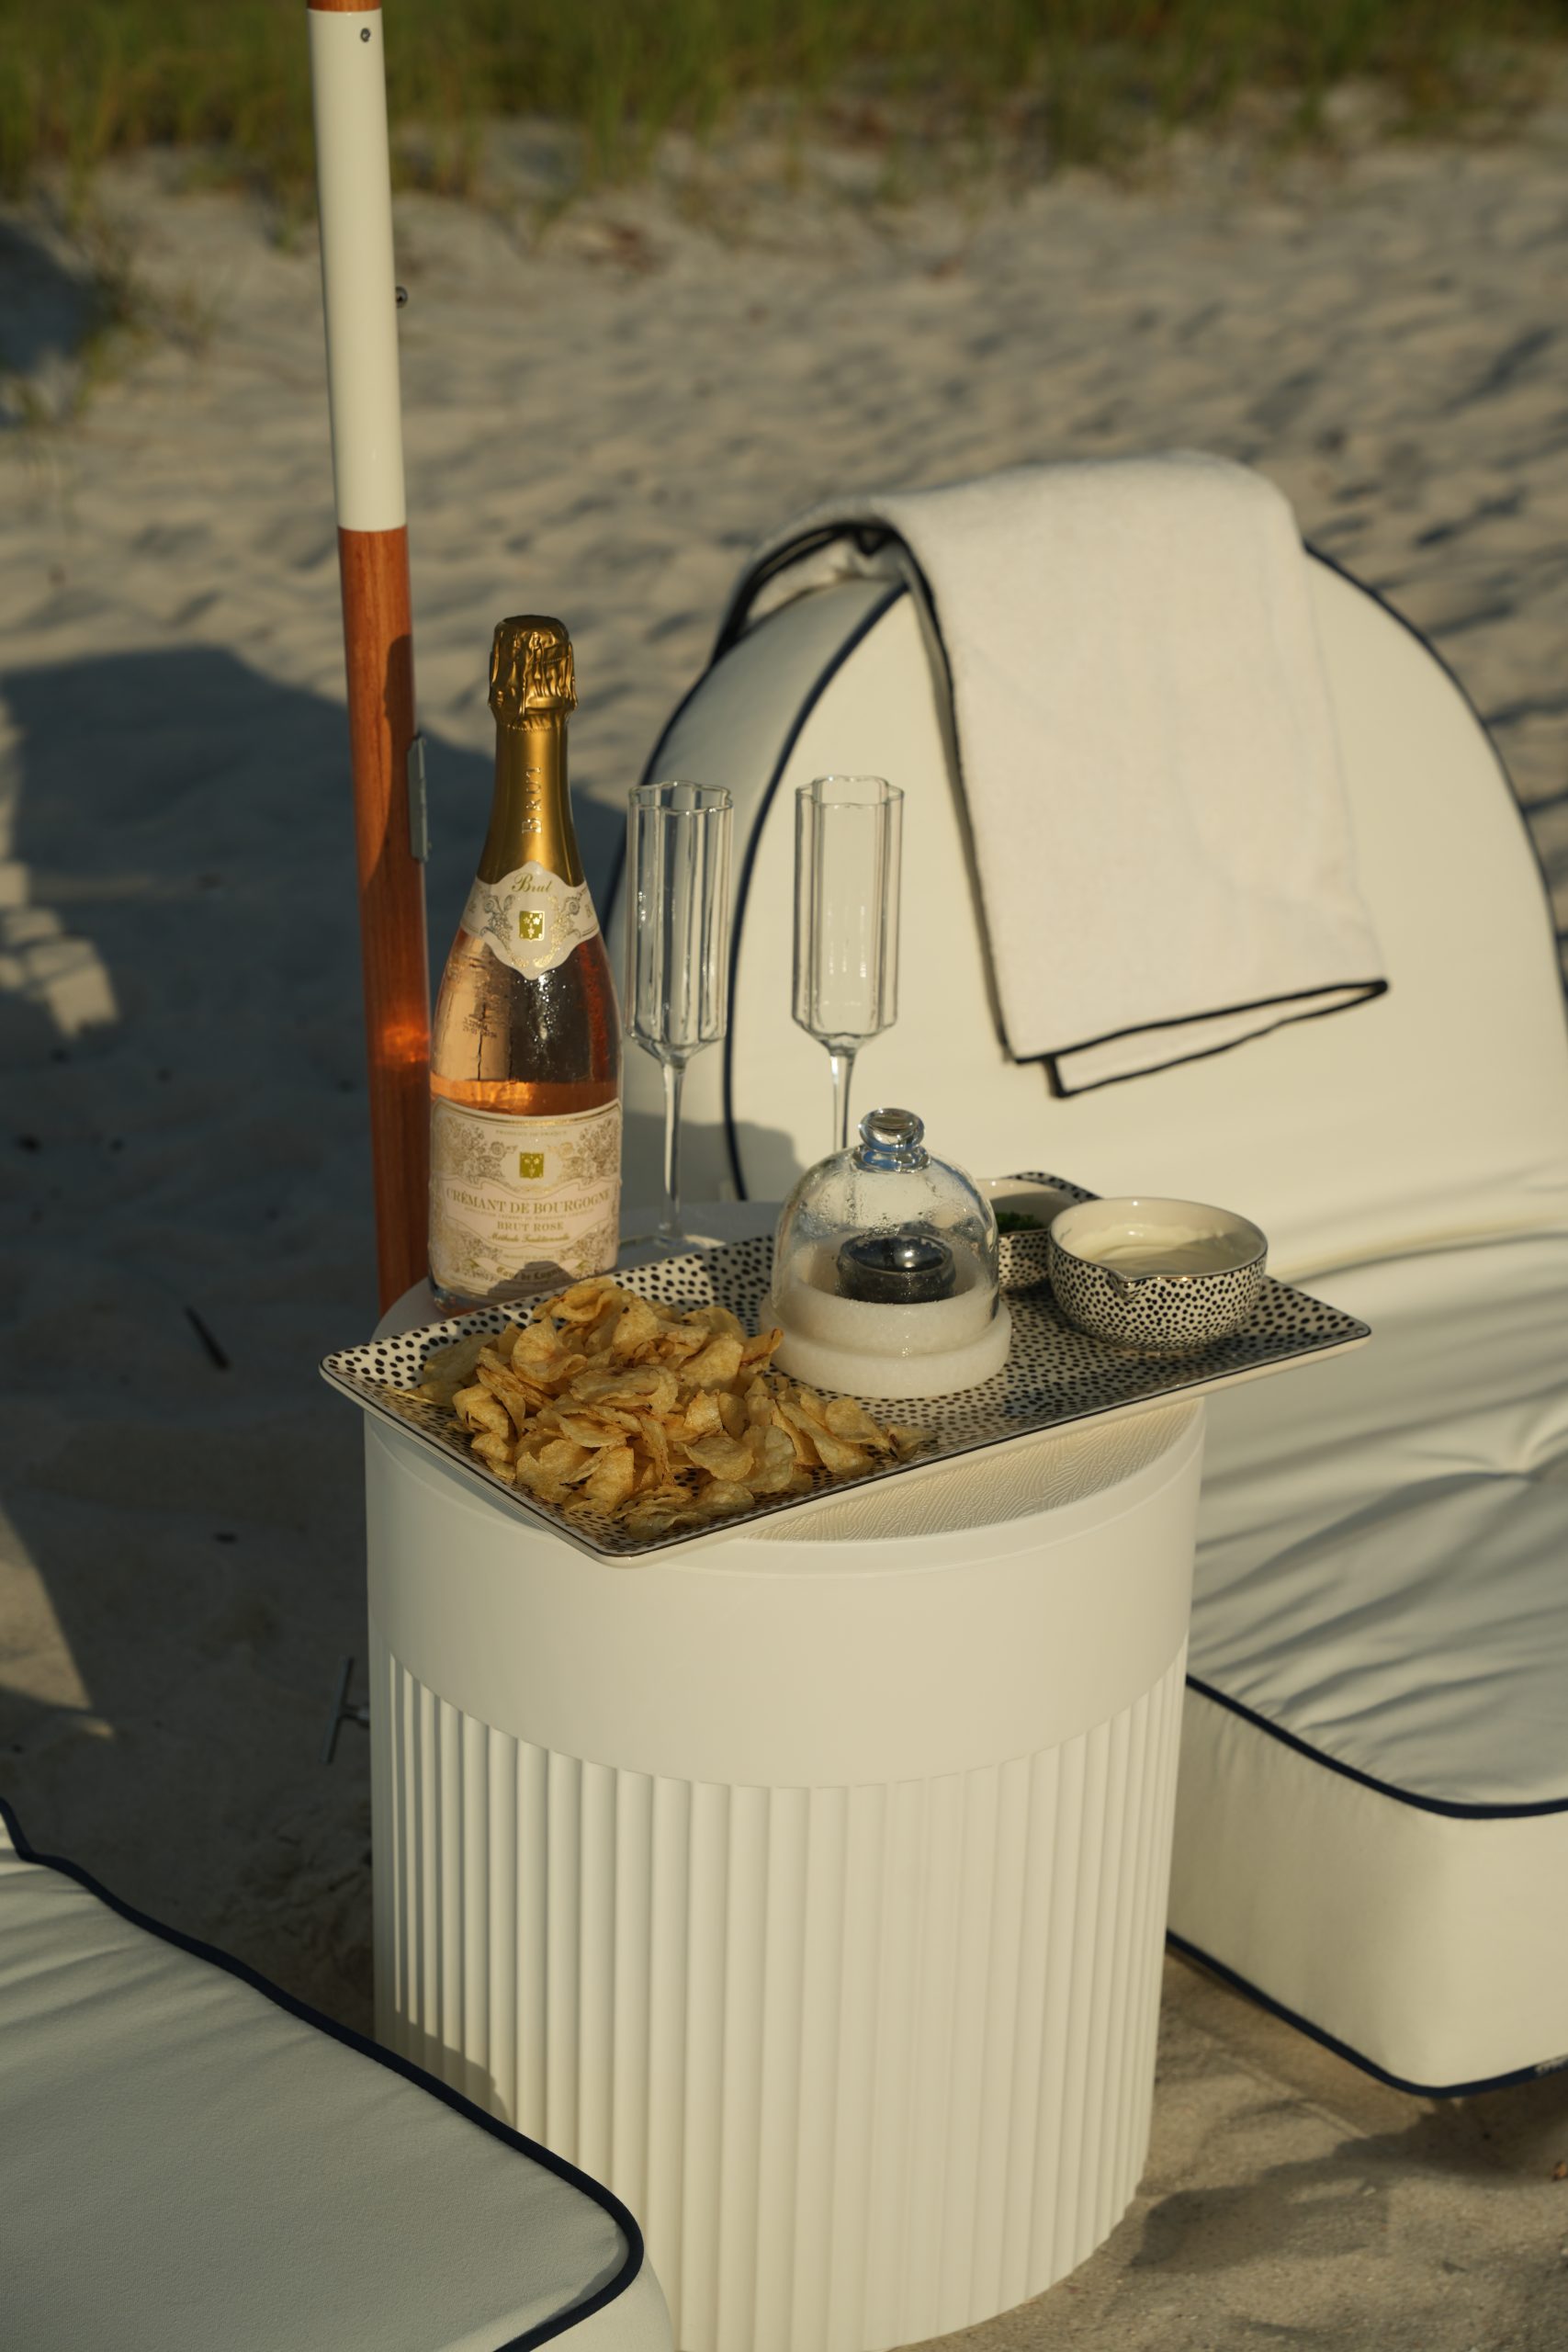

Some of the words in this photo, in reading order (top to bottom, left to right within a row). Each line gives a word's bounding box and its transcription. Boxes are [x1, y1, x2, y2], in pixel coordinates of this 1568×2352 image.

[521, 766, 542, 834] BRUT
[512, 872, 552, 892] Brut
[446, 1187, 506, 1212] CRÉMANT
[511, 1202, 530, 1215] DE
[534, 1189, 611, 1214] BOURGOGNE
[497, 1221, 529, 1232] BRUT
